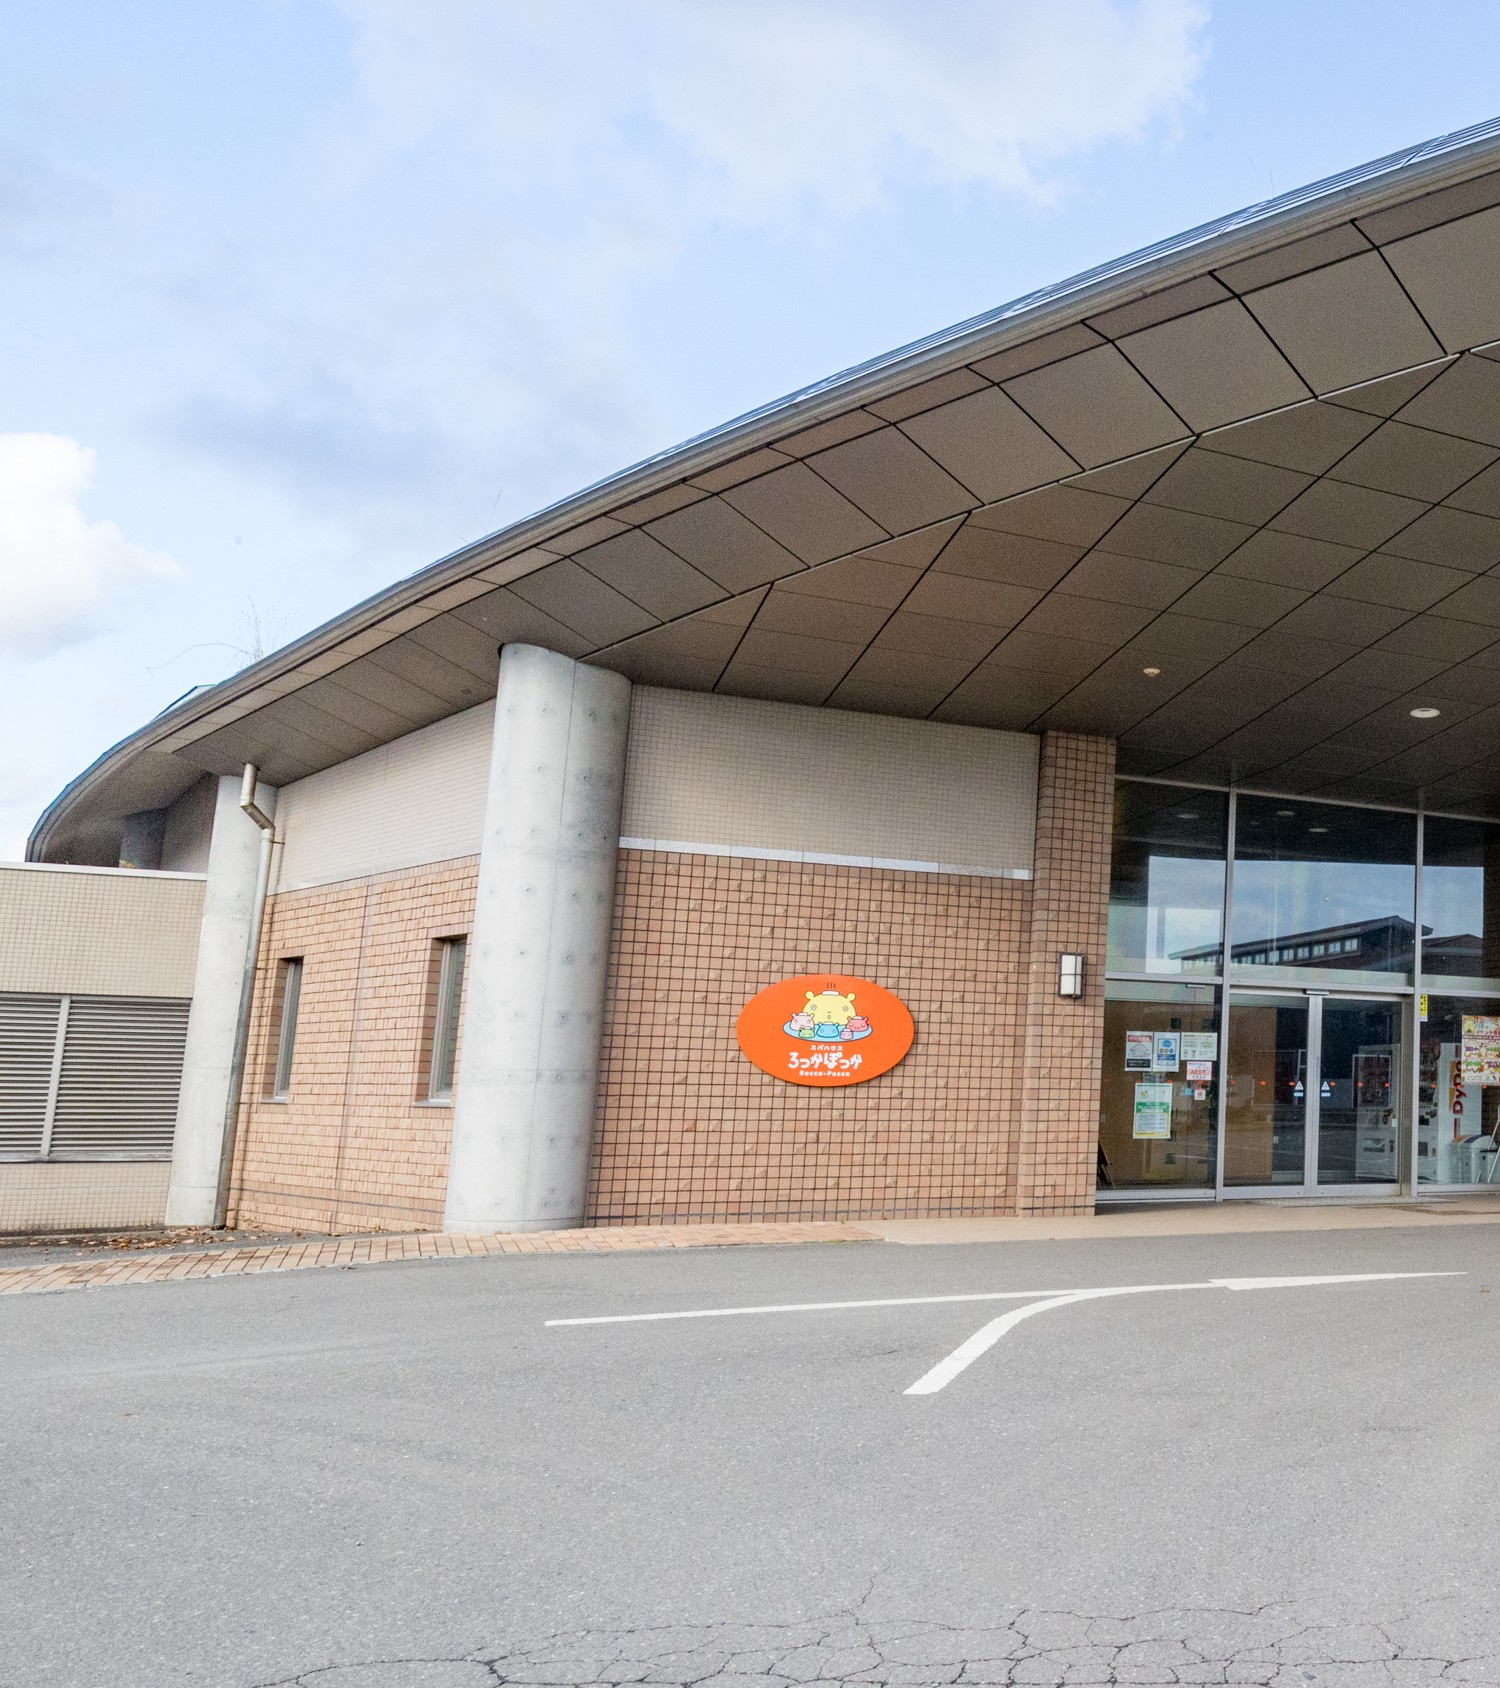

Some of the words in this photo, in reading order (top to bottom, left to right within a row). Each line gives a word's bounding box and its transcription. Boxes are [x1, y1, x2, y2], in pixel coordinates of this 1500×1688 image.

[788, 1051, 863, 1070] ろっかぽっか
